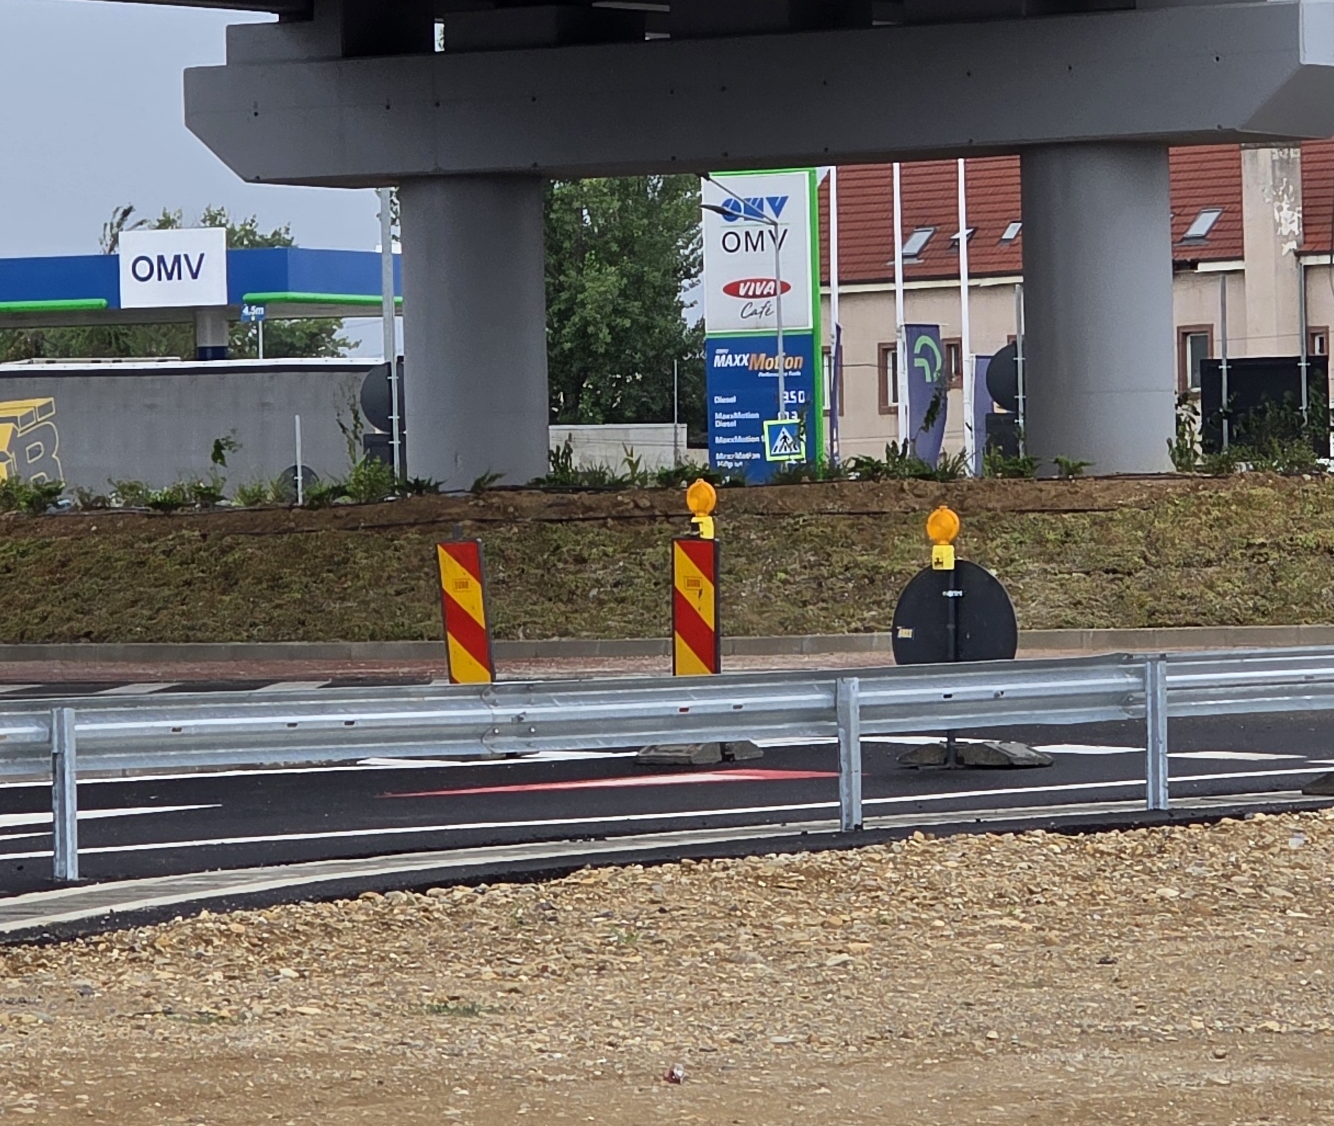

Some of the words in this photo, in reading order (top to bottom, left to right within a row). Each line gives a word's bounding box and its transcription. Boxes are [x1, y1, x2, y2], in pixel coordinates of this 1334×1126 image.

[722, 229, 788, 253] OMV
[131, 253, 205, 282] OMV
[738, 281, 776, 296] VIVA
[741, 301, 774, 319] Café
